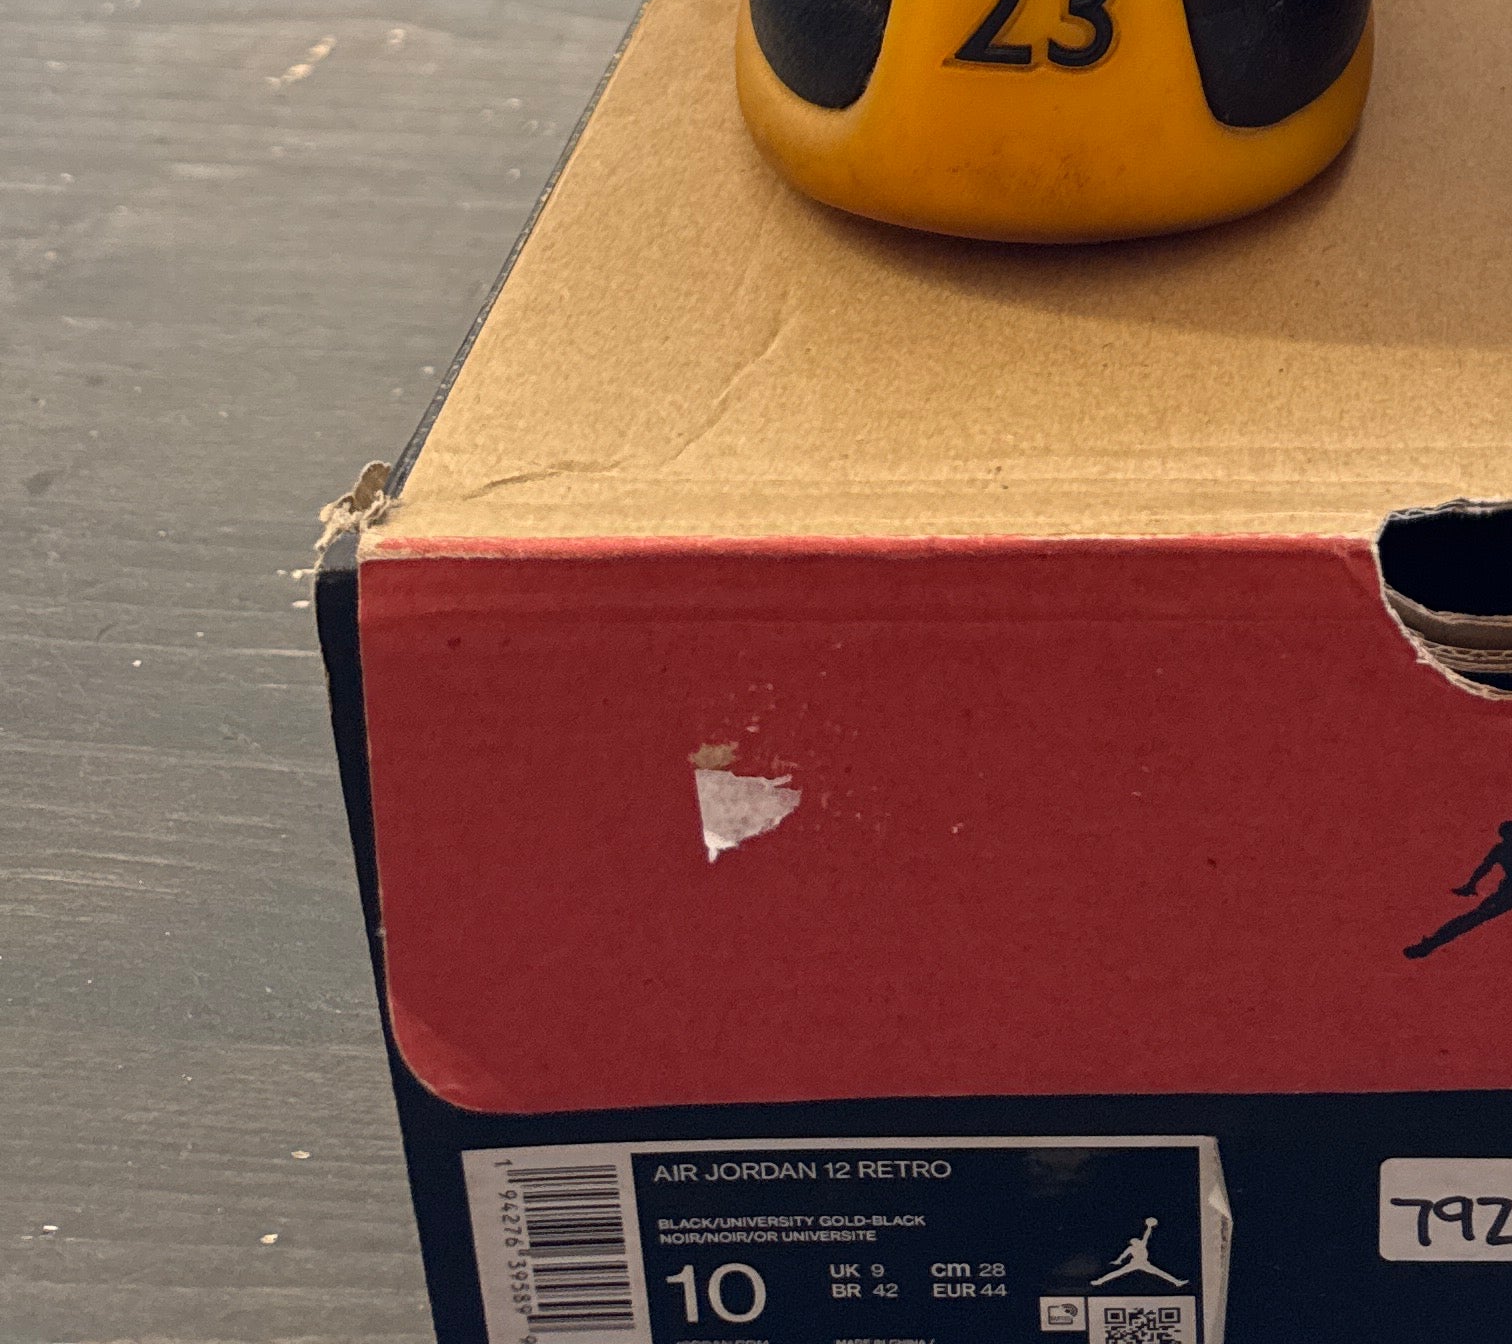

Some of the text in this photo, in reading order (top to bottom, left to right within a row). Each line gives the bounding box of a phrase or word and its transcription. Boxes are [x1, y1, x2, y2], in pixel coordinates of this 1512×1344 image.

[653, 1160, 952, 1182] AIR JORDAN 12 RETRO
[498, 1190, 522, 1248] 94276
[658, 1214, 926, 1230] BLACK/UNIVERSITY GOLD-BLACK
[659, 1229, 877, 1244] NOIR/NOIR/OR UNIVERSITE
[830, 1263, 885, 1278] UK 9
[930, 1262, 1006, 1278] cm 28
[665, 1262, 767, 1324] 10
[831, 1283, 899, 1298] BR 42
[933, 1283, 1007, 1298] EUR 44
